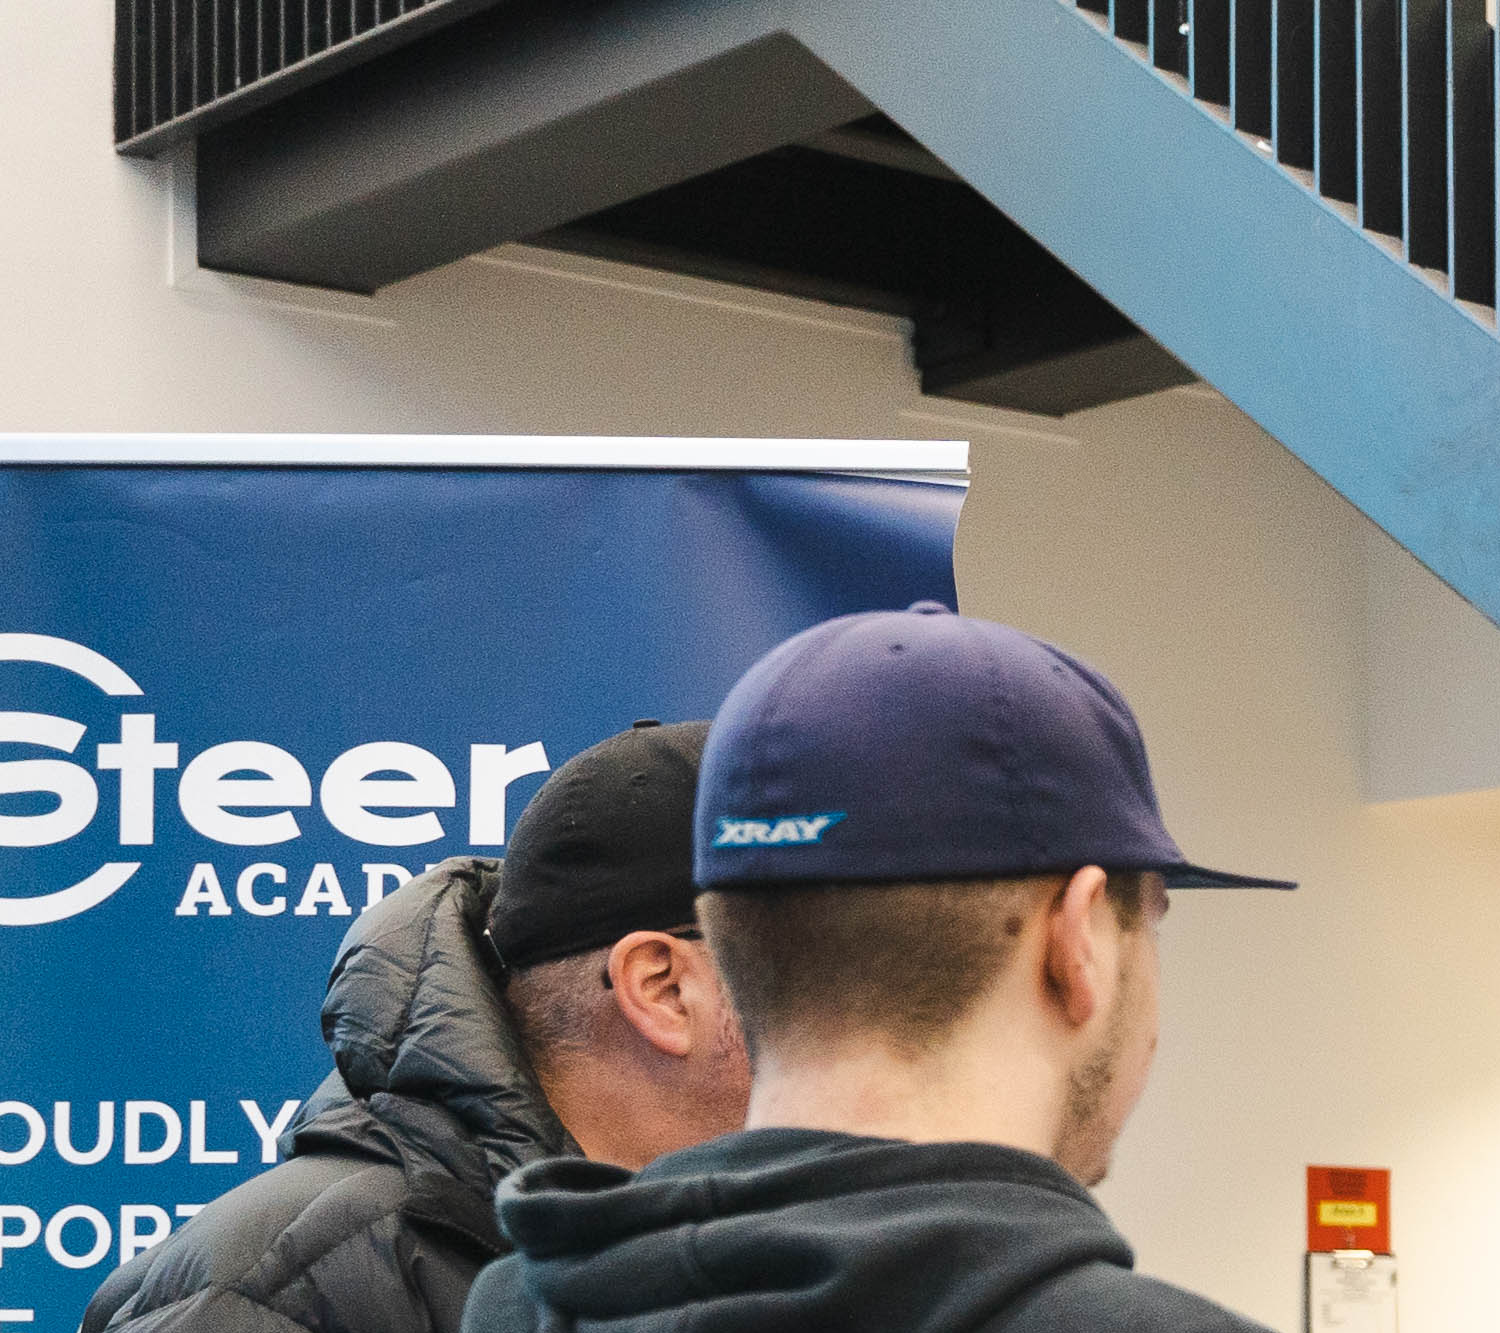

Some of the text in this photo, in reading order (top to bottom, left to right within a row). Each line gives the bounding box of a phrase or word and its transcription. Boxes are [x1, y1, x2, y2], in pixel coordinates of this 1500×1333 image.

[0, 710, 550, 848] Steer
[717, 816, 831, 845] XRAY
[175, 862, 435, 916] ACAD
